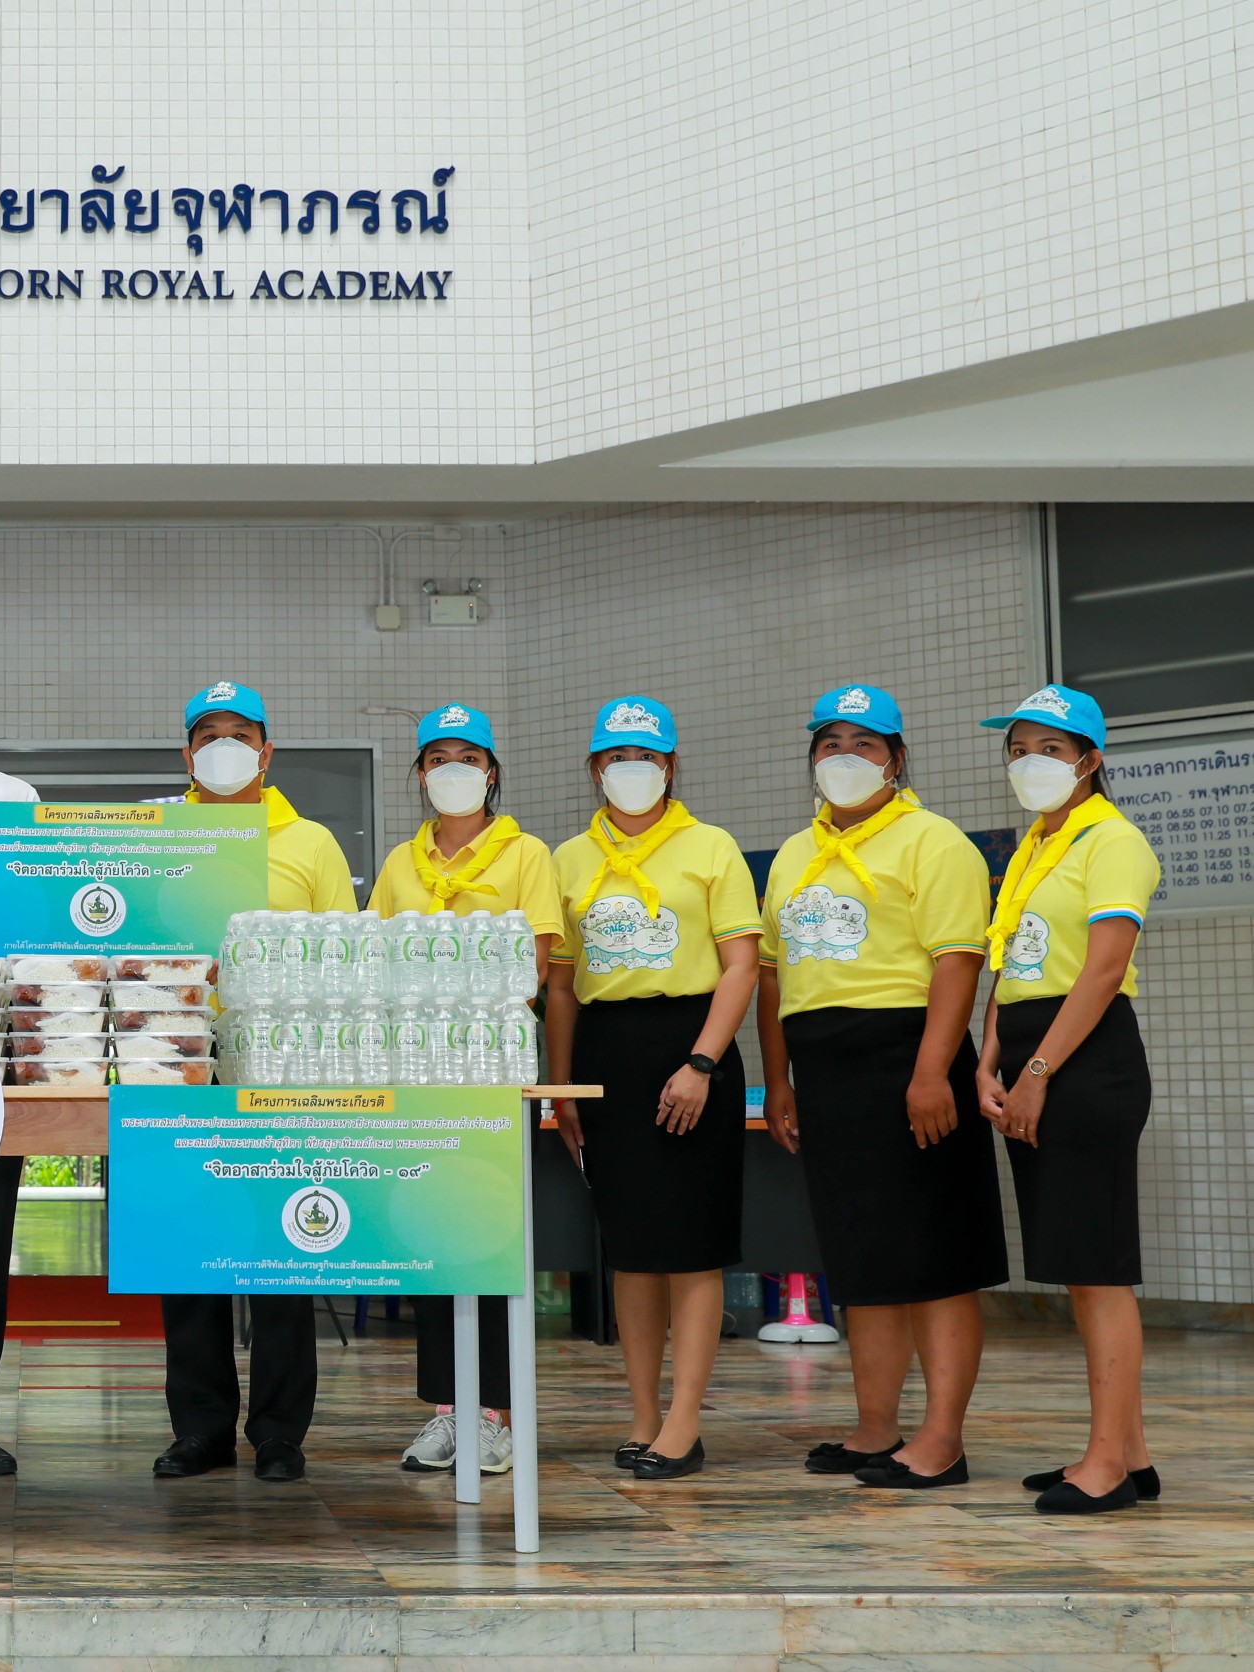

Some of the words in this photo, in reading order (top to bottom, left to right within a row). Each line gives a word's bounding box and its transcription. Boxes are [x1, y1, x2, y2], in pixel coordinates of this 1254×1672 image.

[101, 269, 234, 300] ROYAL
[250, 269, 453, 301] ACADEMY
[44, 808, 155, 821] โครงการเฉลิมพระเกียรติ
[1133, 811, 1162, 823] 06.40
[1166, 808, 1195, 820] 06.55
[1199, 805, 1229, 817] 07.10
[1167, 821, 1196, 832] 08.50
[1200, 818, 1230, 829] 09.10
[1169, 833, 1197, 844] 11.10
[1203, 830, 1231, 842] 11.25
[1170, 850, 1198, 862] 12.30
[1204, 848, 1232, 859] 12.50
[1171, 863, 1199, 874] 14.40
[1205, 860, 1233, 872] 14.55
[1172, 876, 1200, 887] 16.25
[1206, 873, 1234, 885] 16.40
[249, 1092, 385, 1108] โครงการเฉลิมพระเกียรติ
[204, 1157, 380, 1184] “จิตอาสาร่วมใจสู้ภัยโควิด
